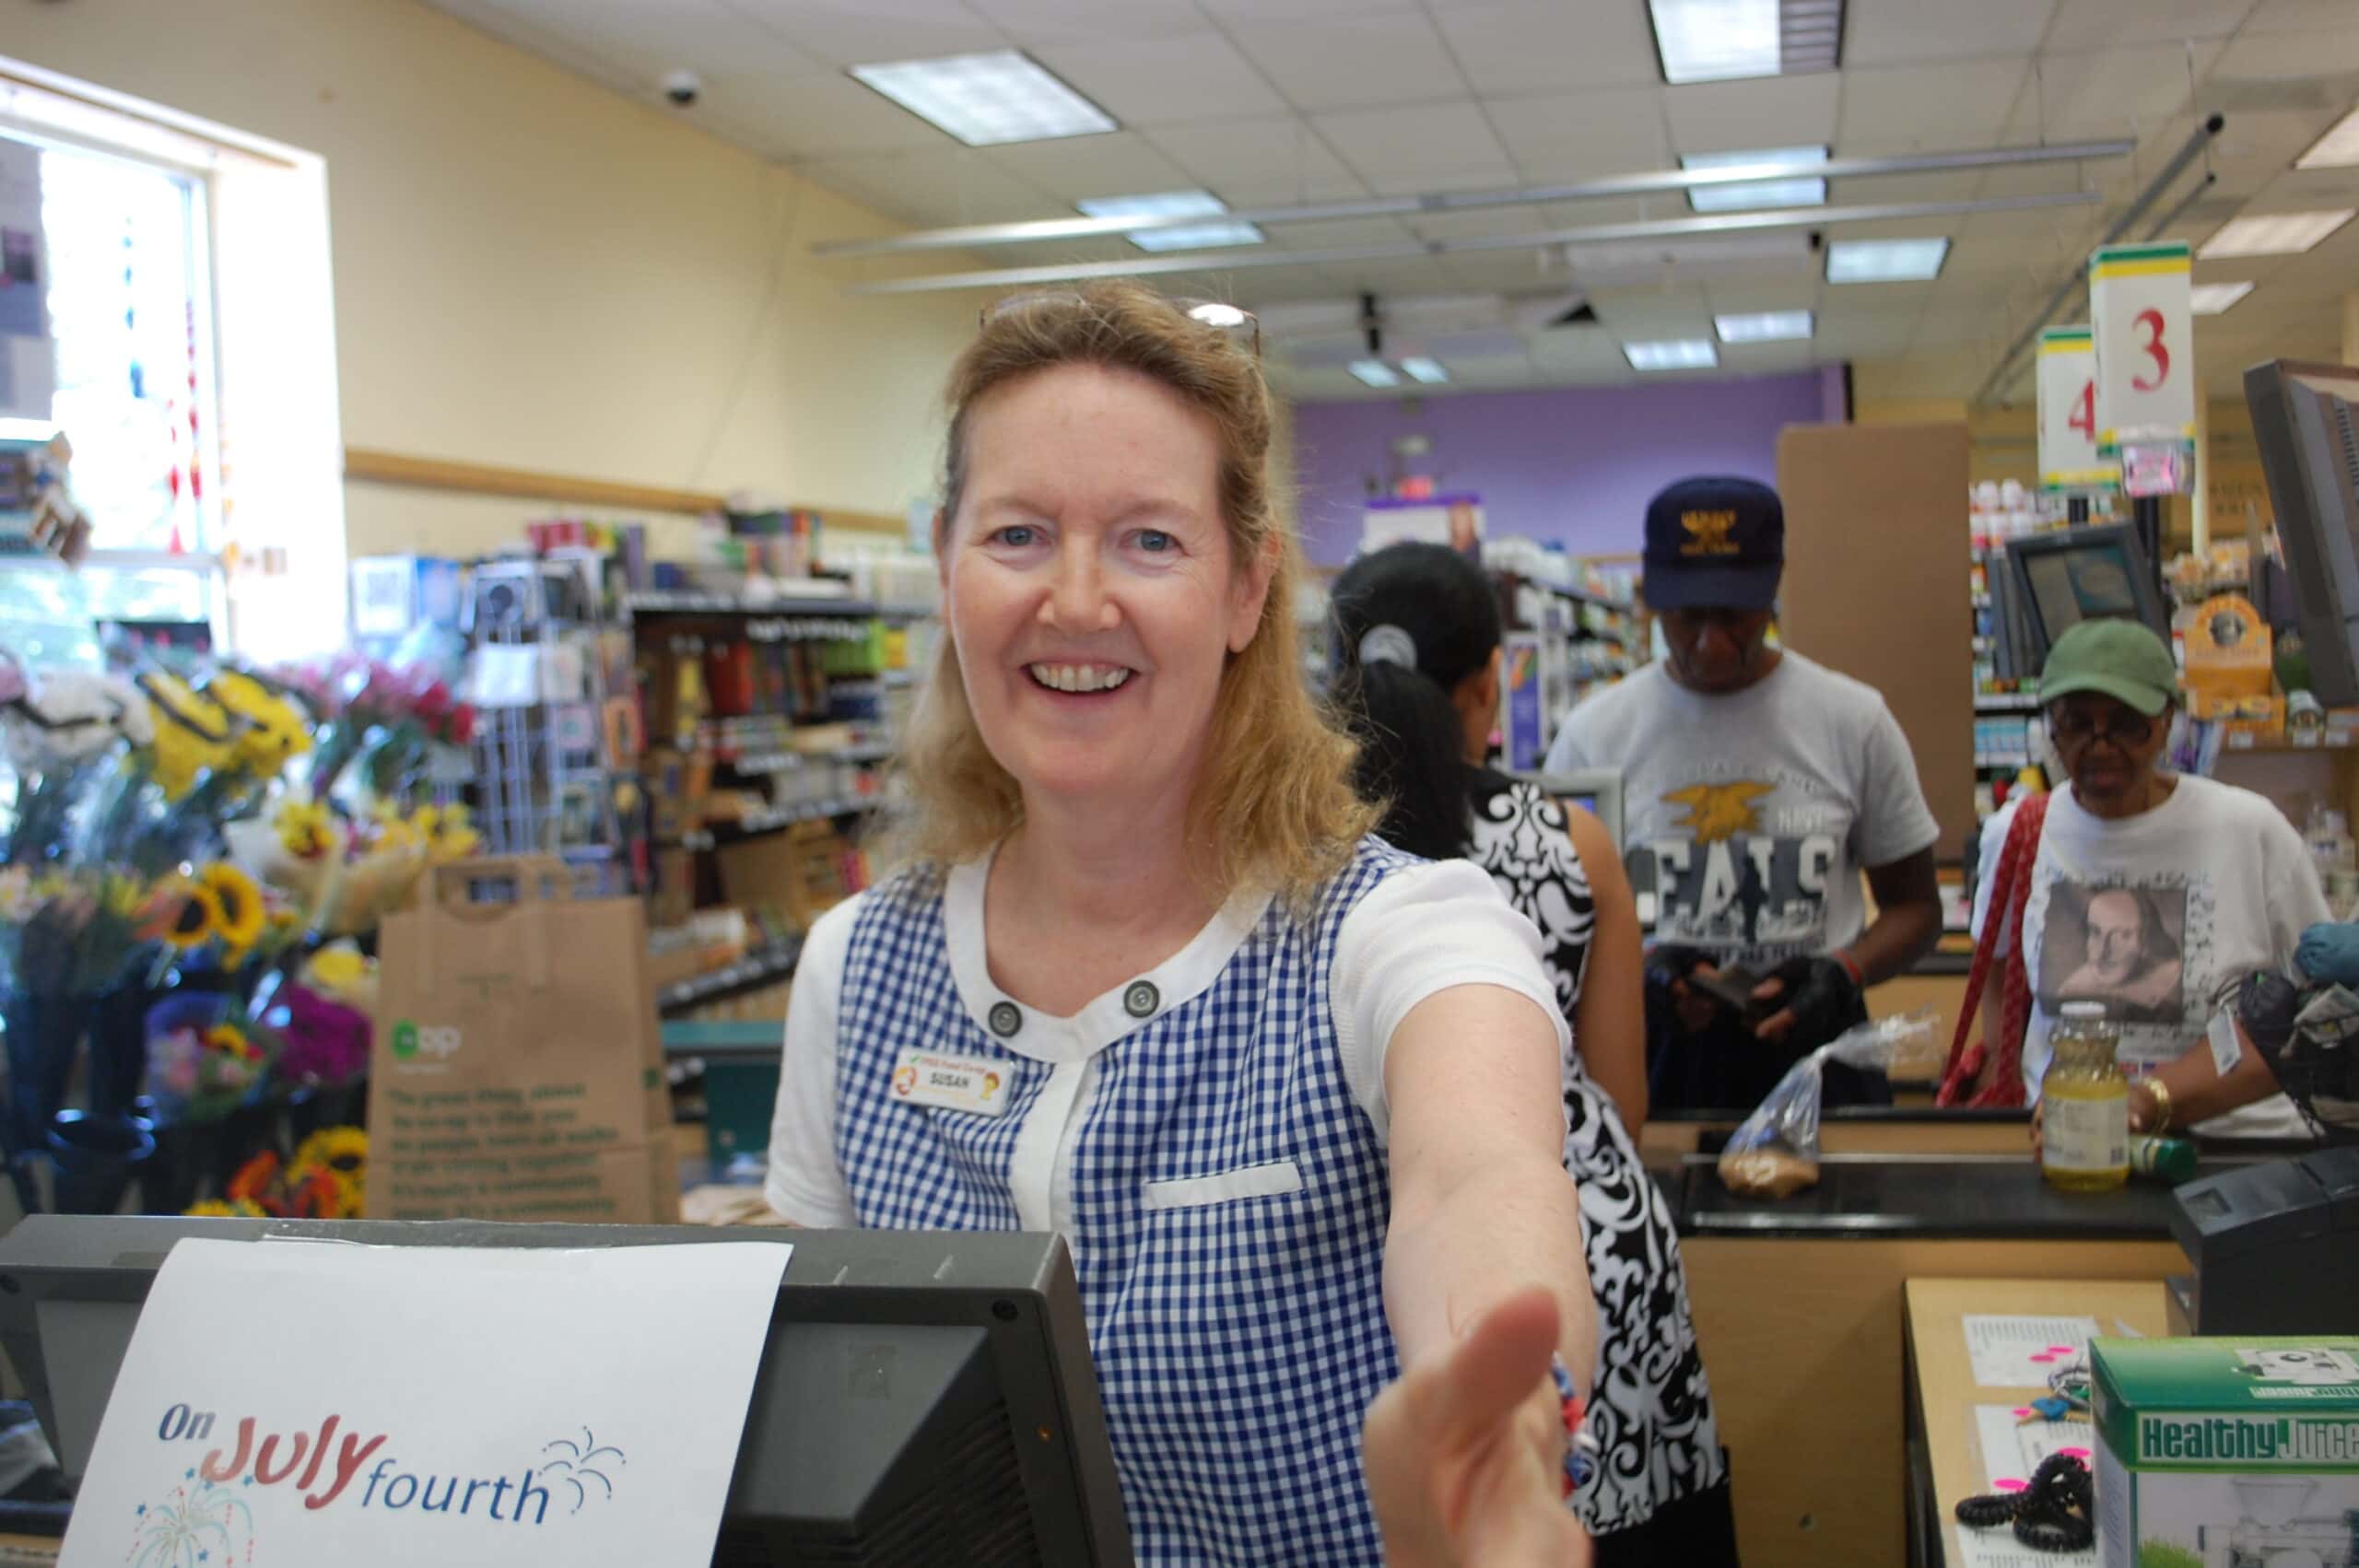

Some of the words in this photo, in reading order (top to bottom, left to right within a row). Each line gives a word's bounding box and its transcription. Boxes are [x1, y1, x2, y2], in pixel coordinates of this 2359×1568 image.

[2131, 307, 2170, 392] 3
[2068, 378, 2095, 443] 4
[930, 1071, 969, 1087] SUSAN
[158, 1403, 217, 1440] On
[200, 1414, 388, 1510] July
[361, 1458, 550, 1525] fourth
